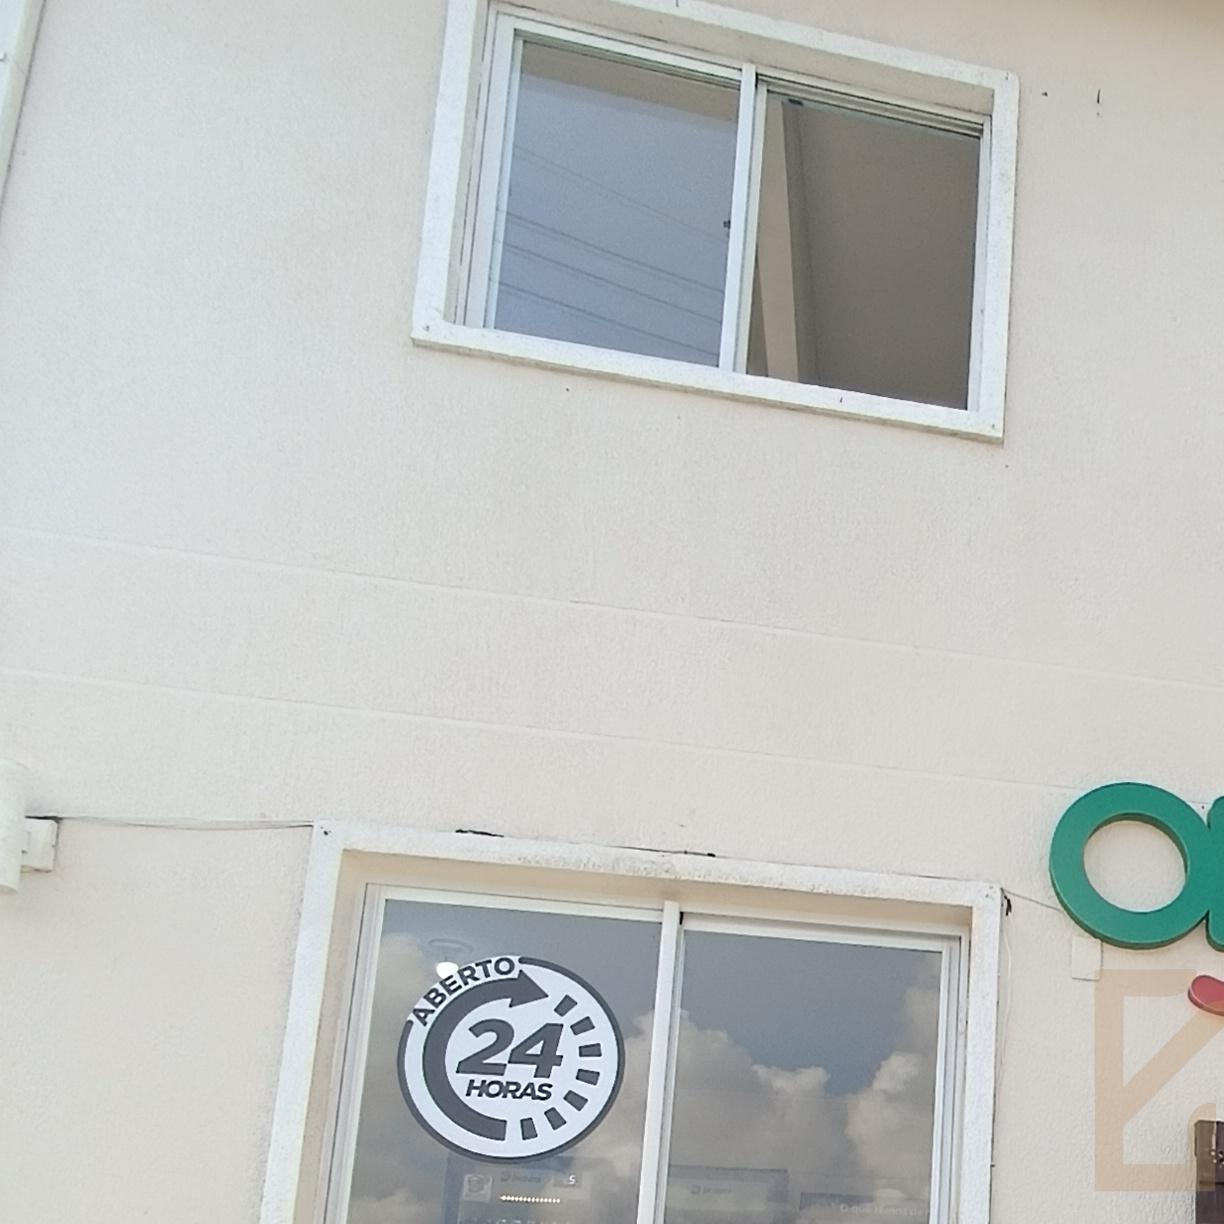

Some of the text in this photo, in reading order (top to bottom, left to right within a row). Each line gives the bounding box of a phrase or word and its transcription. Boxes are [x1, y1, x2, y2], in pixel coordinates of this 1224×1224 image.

[412, 957, 515, 1027] ABERTO
[456, 1018, 564, 1079] 24
[465, 1079, 553, 1101] HORAS
